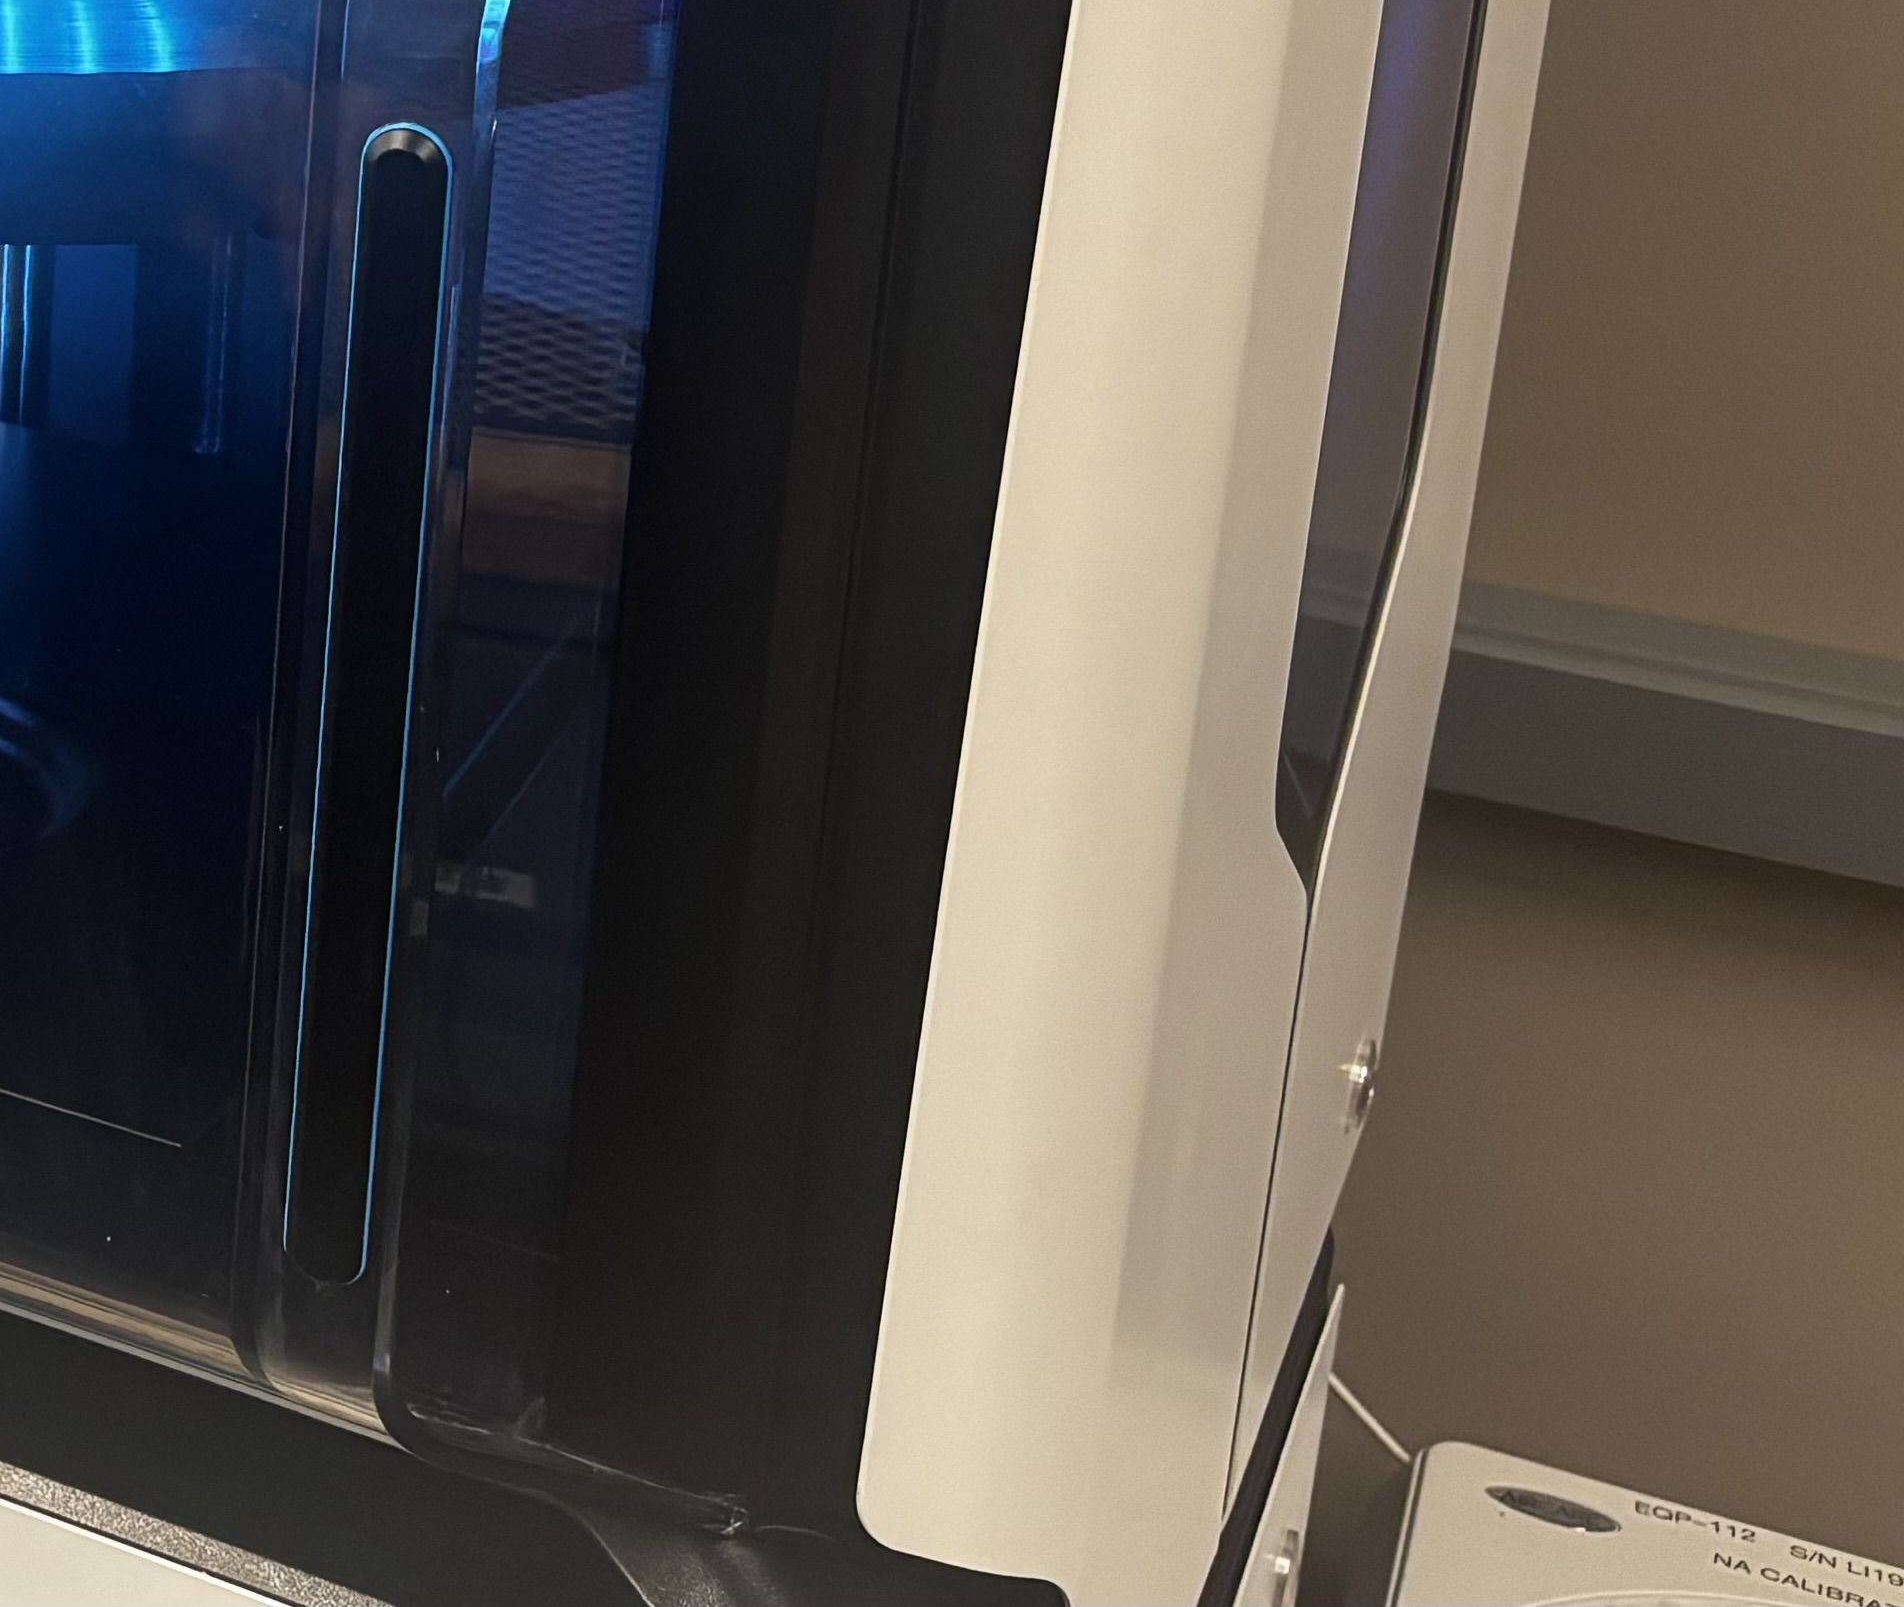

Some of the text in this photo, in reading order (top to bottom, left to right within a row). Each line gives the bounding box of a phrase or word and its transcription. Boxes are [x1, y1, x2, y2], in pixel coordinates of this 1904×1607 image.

[1634, 1499, 1757, 1544] EQP-112
[1789, 1544, 1837, 1569] S/N
[1712, 1551, 1752, 1576] NA
